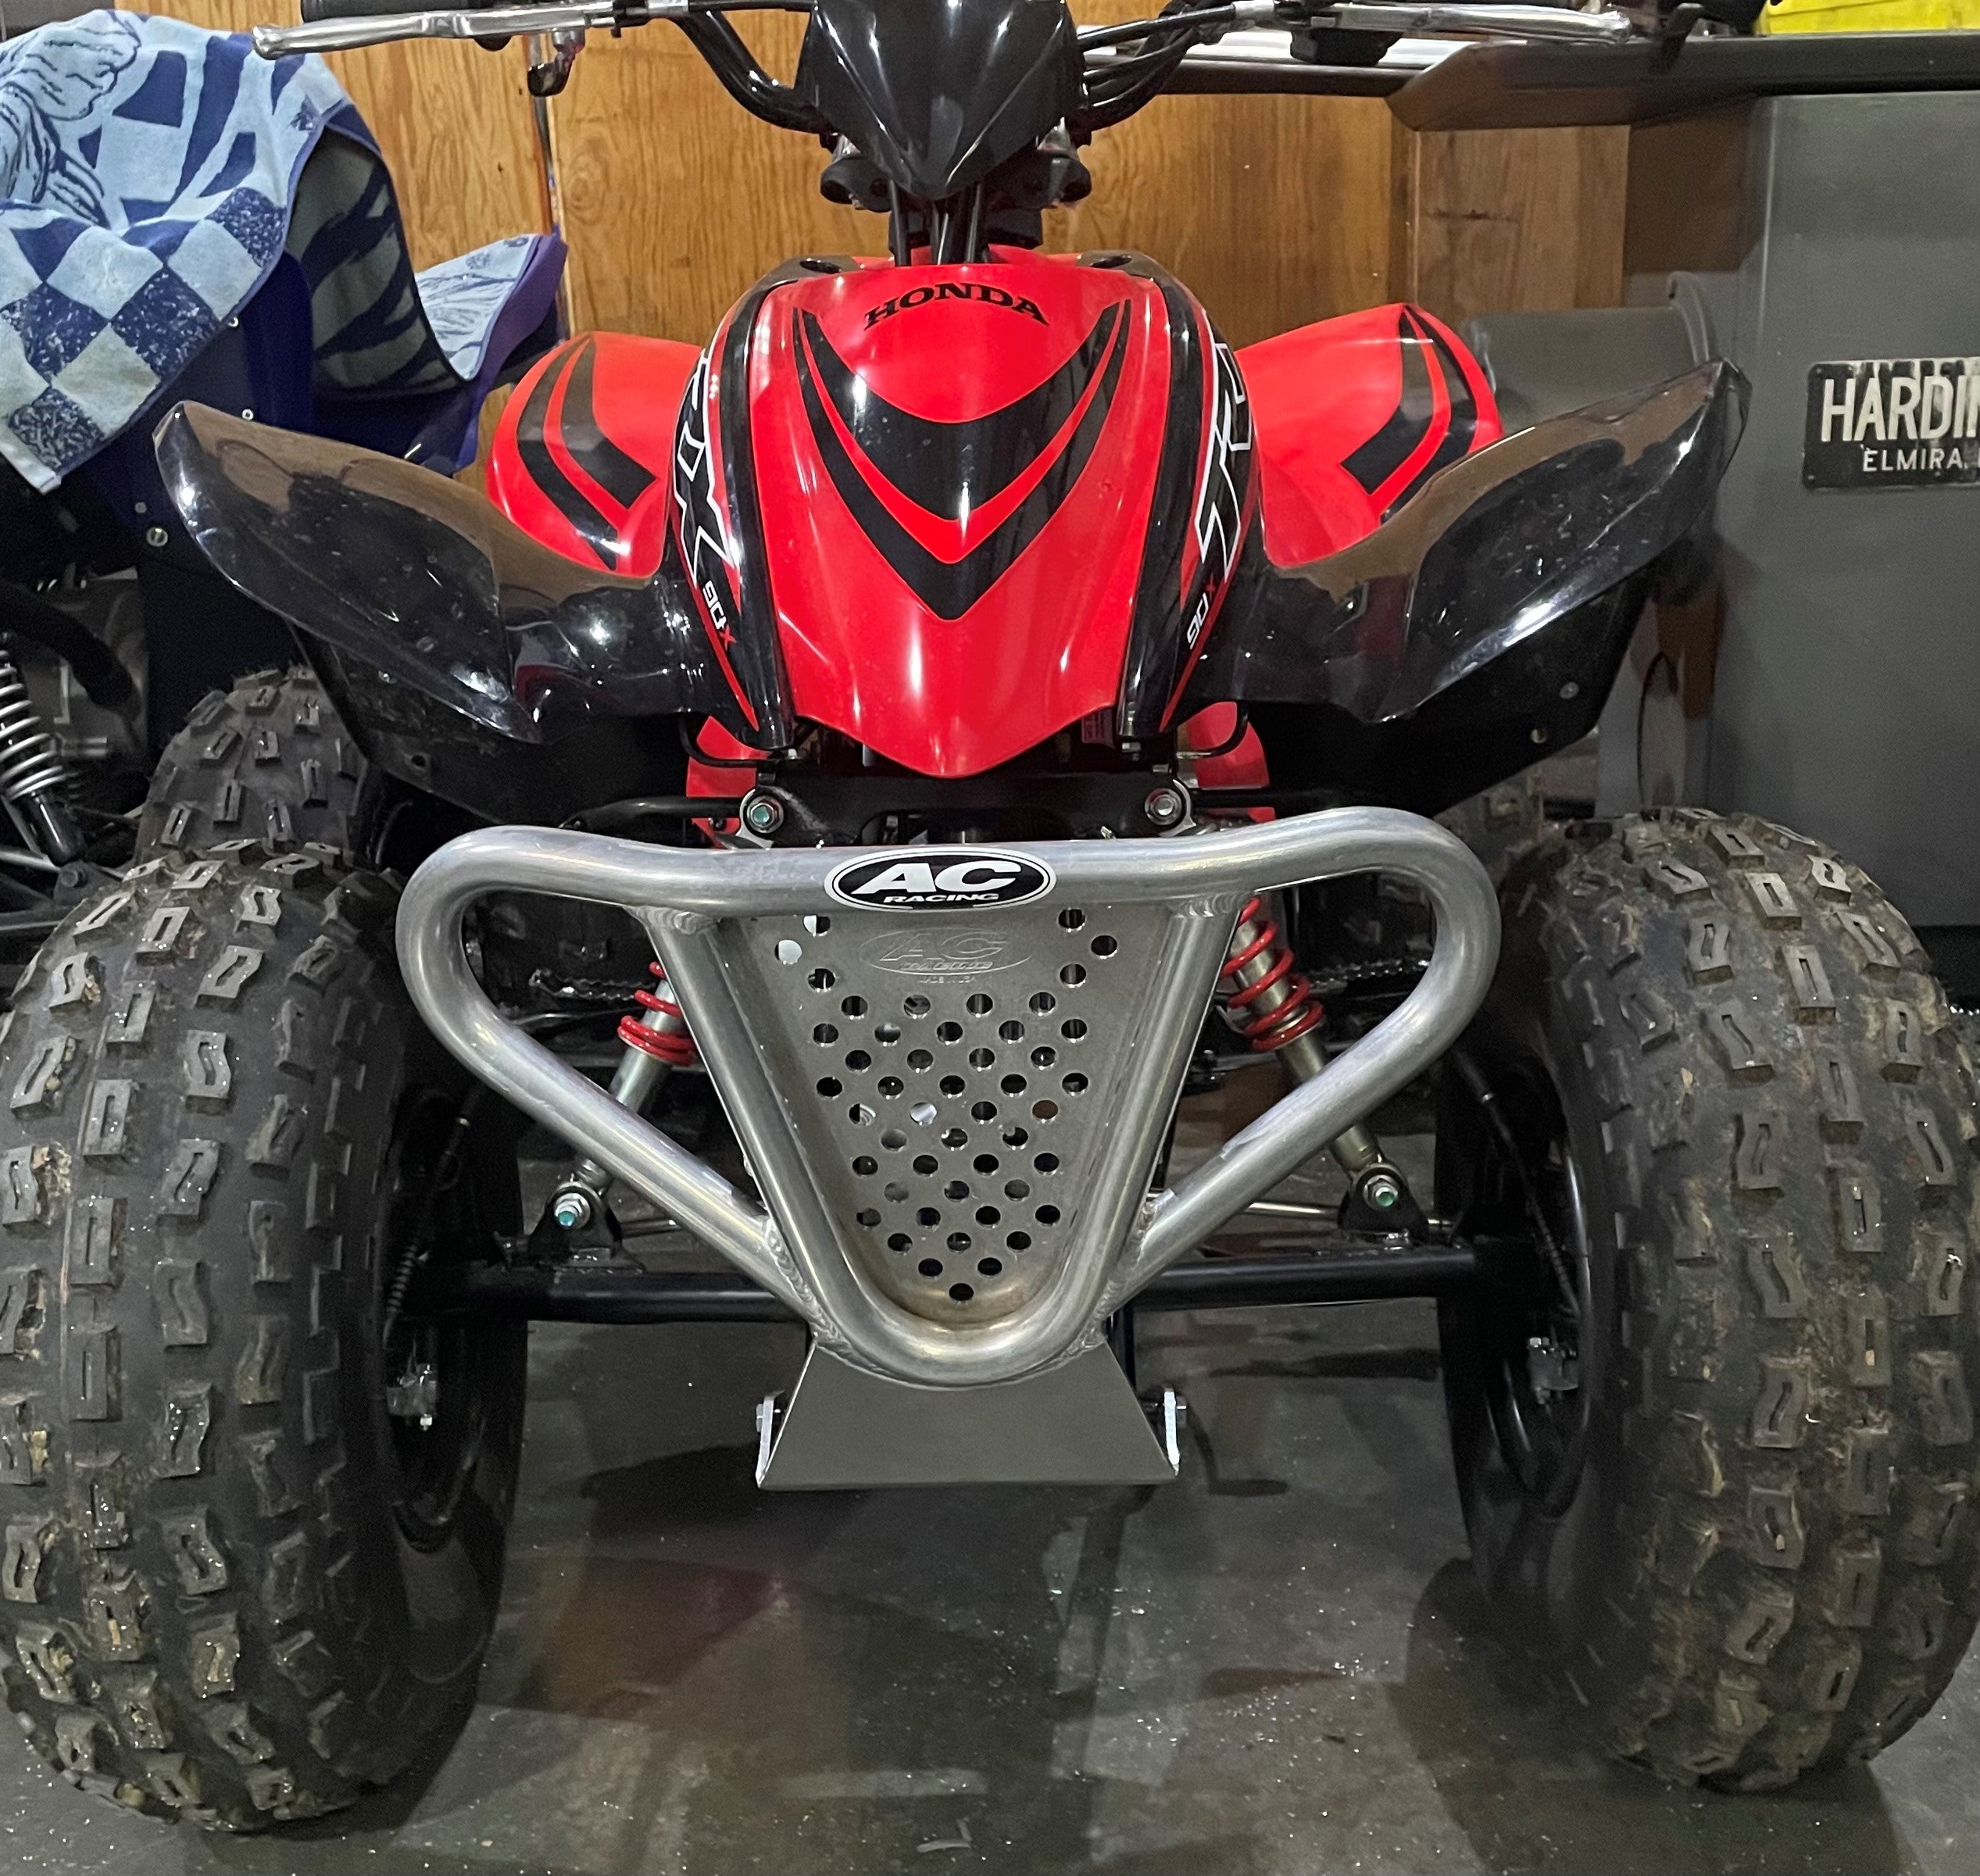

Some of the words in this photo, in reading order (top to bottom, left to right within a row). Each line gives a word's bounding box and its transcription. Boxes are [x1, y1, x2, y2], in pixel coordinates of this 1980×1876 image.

[864, 282, 1050, 331] HONDA
[850, 859, 1022, 895] AC
[883, 893, 999, 903] RACING
